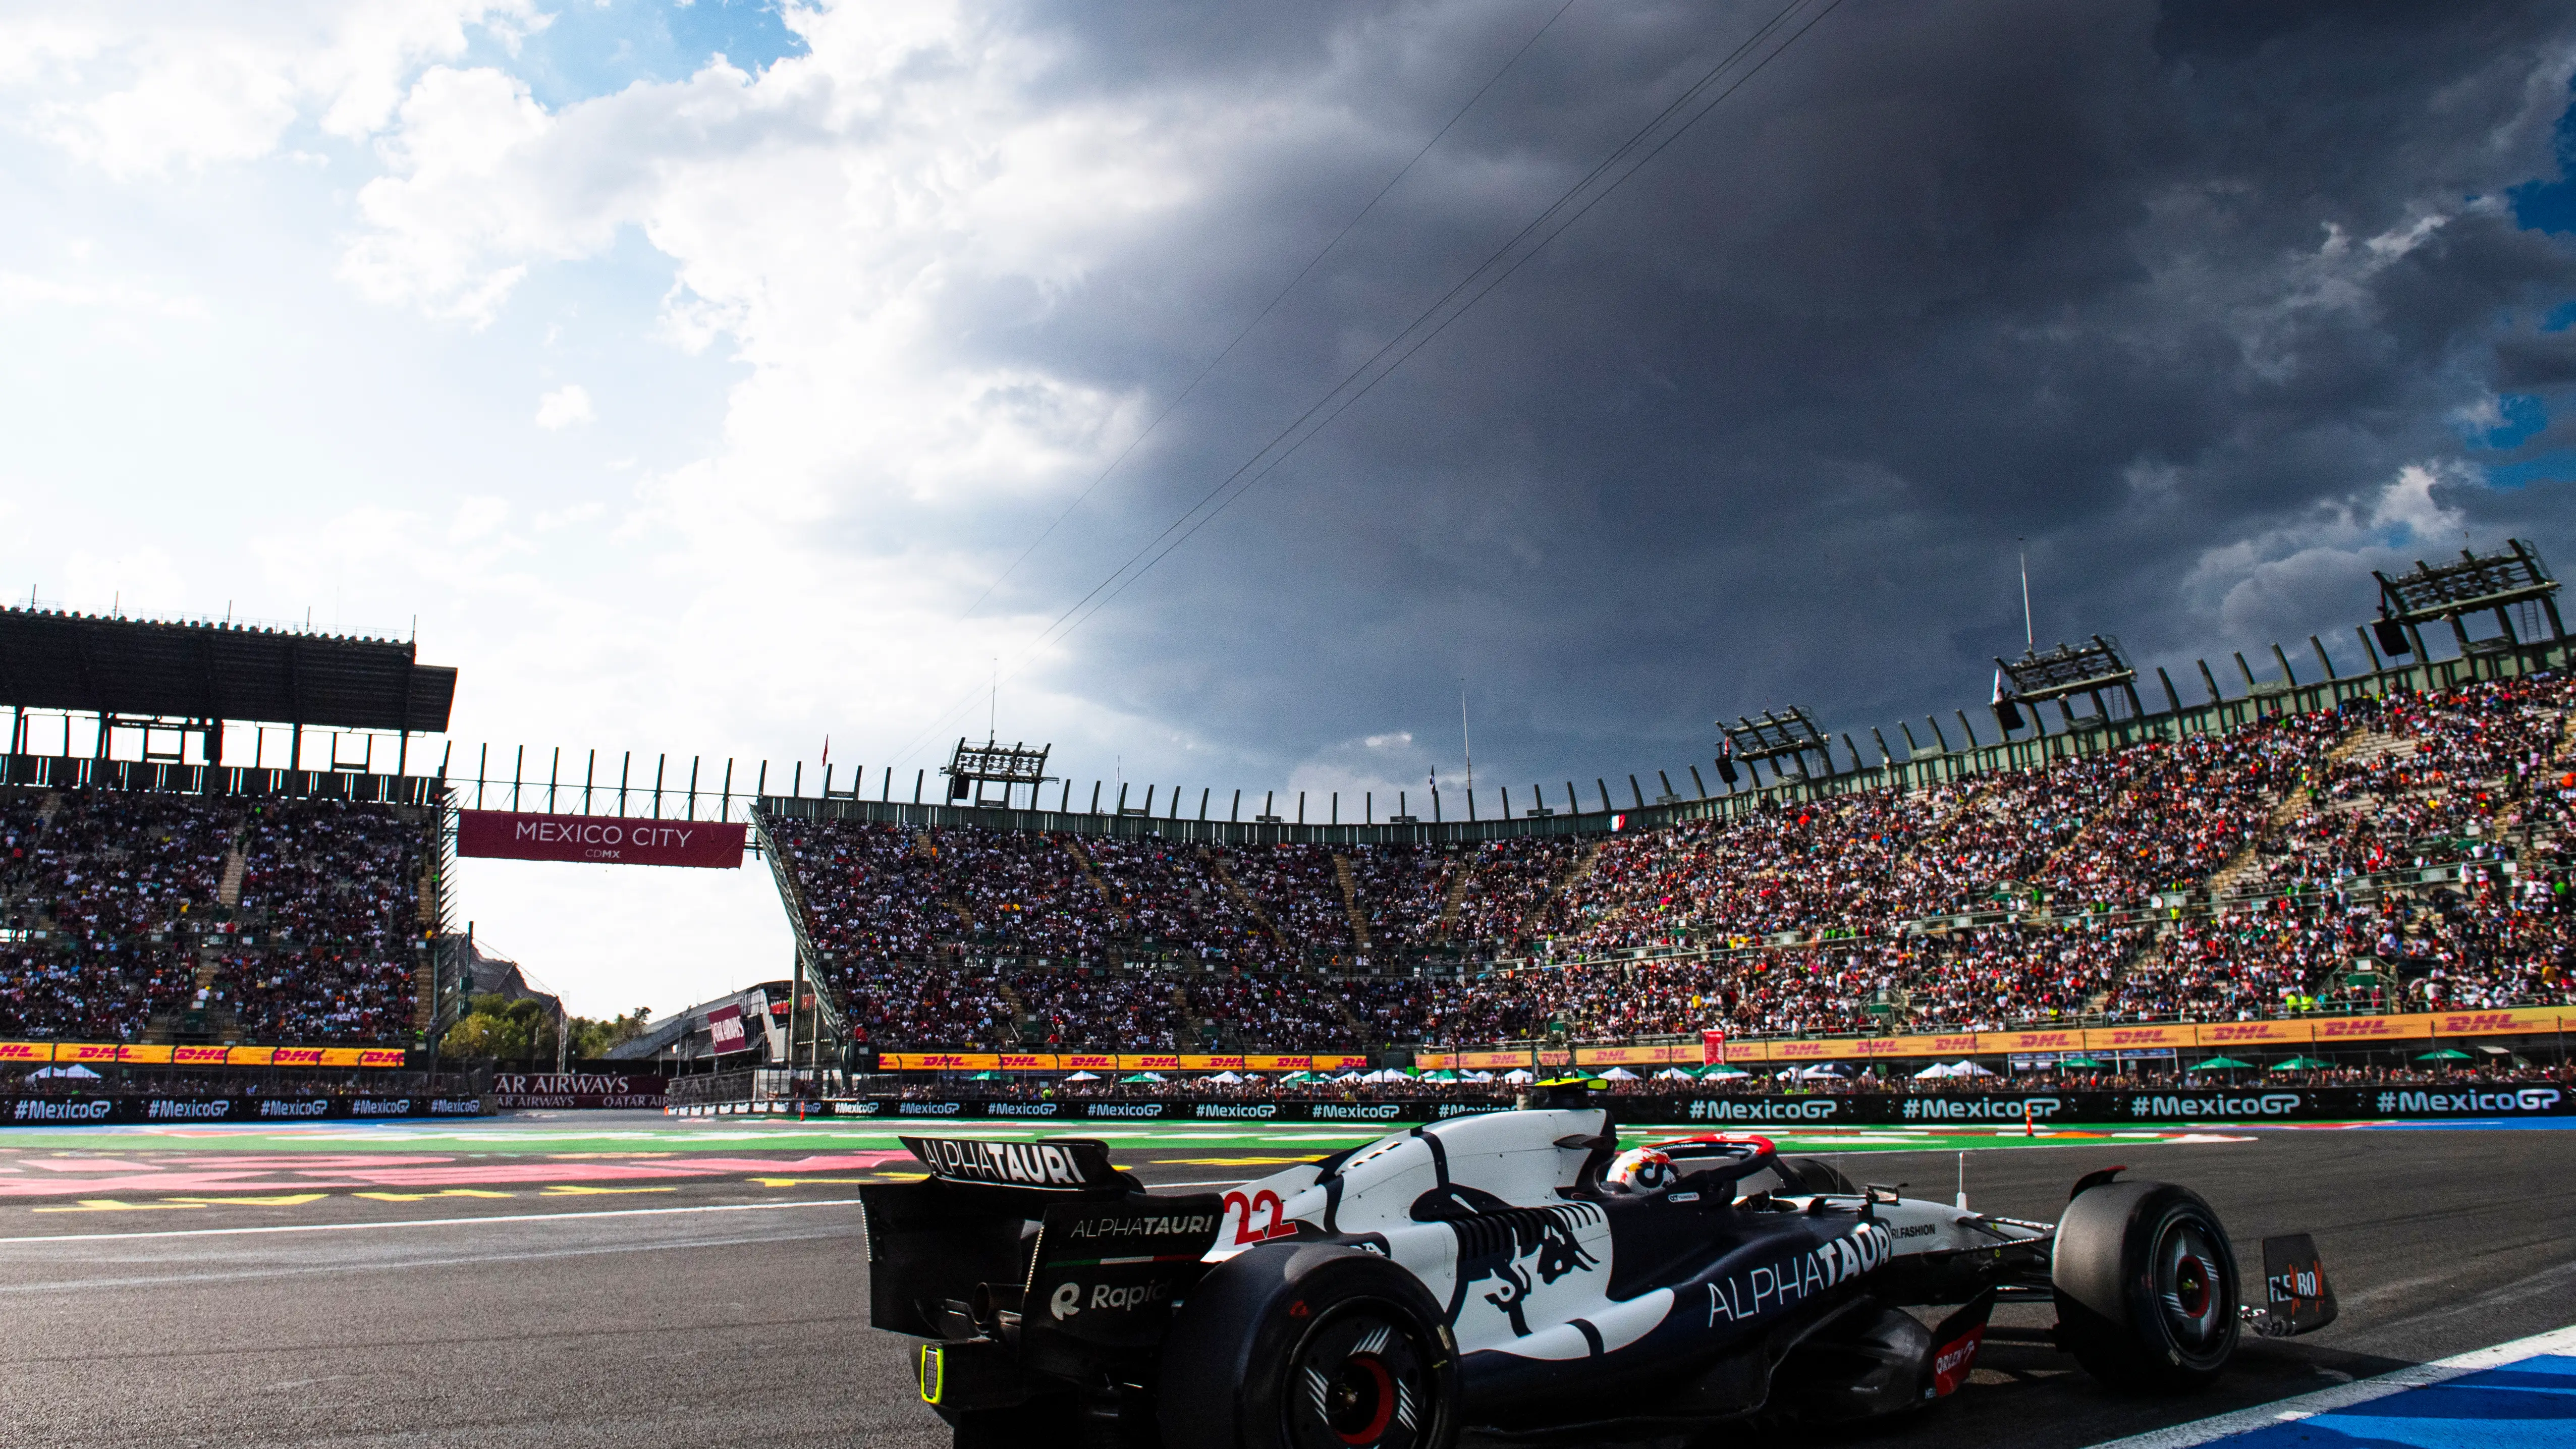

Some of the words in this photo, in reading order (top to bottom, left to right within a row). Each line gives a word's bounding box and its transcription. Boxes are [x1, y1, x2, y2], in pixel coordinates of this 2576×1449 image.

[516, 821, 623, 844] MEXICO
[632, 827, 693, 847] CITY
[585, 849, 621, 858] CDMX
[2325, 1019, 2389, 1036] DHL
[2446, 1014, 2517, 1031] DHL
[2112, 1029, 2166, 1044] DHL
[2214, 1025, 2273, 1040] DHL
[1857, 1040, 1898, 1053] DHL
[1935, 1038, 1980, 1050] DHL
[2020, 1034, 2069, 1047] DHL
[80, 1047, 131, 1058] DHL
[177, 1048, 227, 1060] DHL
[1596, 1049, 1627, 1062] DHL
[1784, 1043, 1823, 1055] DHL
[274, 1050, 321, 1062] DHL
[922, 1056, 964, 1066] DHL
[998, 1056, 1038, 1066] DHL
[1070, 1057, 1109, 1066] DHL
[1141, 1057, 1178, 1066] DHL
[1210, 1057, 1245, 1067] DHL
[1277, 1057, 1311, 1067] DHL
[1491, 1054, 1518, 1065] DHL
[533, 1076, 629, 1093] AIRWAYS
[353, 1099, 410, 1114] #MexicoGP
[517, 1095, 575, 1107] AIRWAYS
[604, 1095, 646, 1107] QATAR
[2131, 1093, 2301, 1116] #MexicoGP
[2376, 1088, 2561, 1112] #MexicoGP
[15, 1099, 111, 1119] #MexicoGP
[149, 1099, 230, 1118] #MexicoGP
[261, 1099, 327, 1116] #MexicoGP
[900, 1102, 960, 1114] #MexicoGP
[988, 1102, 1057, 1115] #MexicoGP
[1087, 1103, 1162, 1116] #MexicoGP
[1196, 1103, 1276, 1118] #MexicoGP
[1312, 1104, 1400, 1118] #MexicoGP
[1689, 1099, 1837, 1119] #MexicoGP
[1902, 1097, 2061, 1118] #MexicoGP
[923, 1140, 1086, 1184] ALPHATAURI
[1224, 1189, 1299, 1246] 22
[1071, 1215, 1213, 1238] ALPHATAURI
[1936, 1348, 1963, 1375] ORLEN
